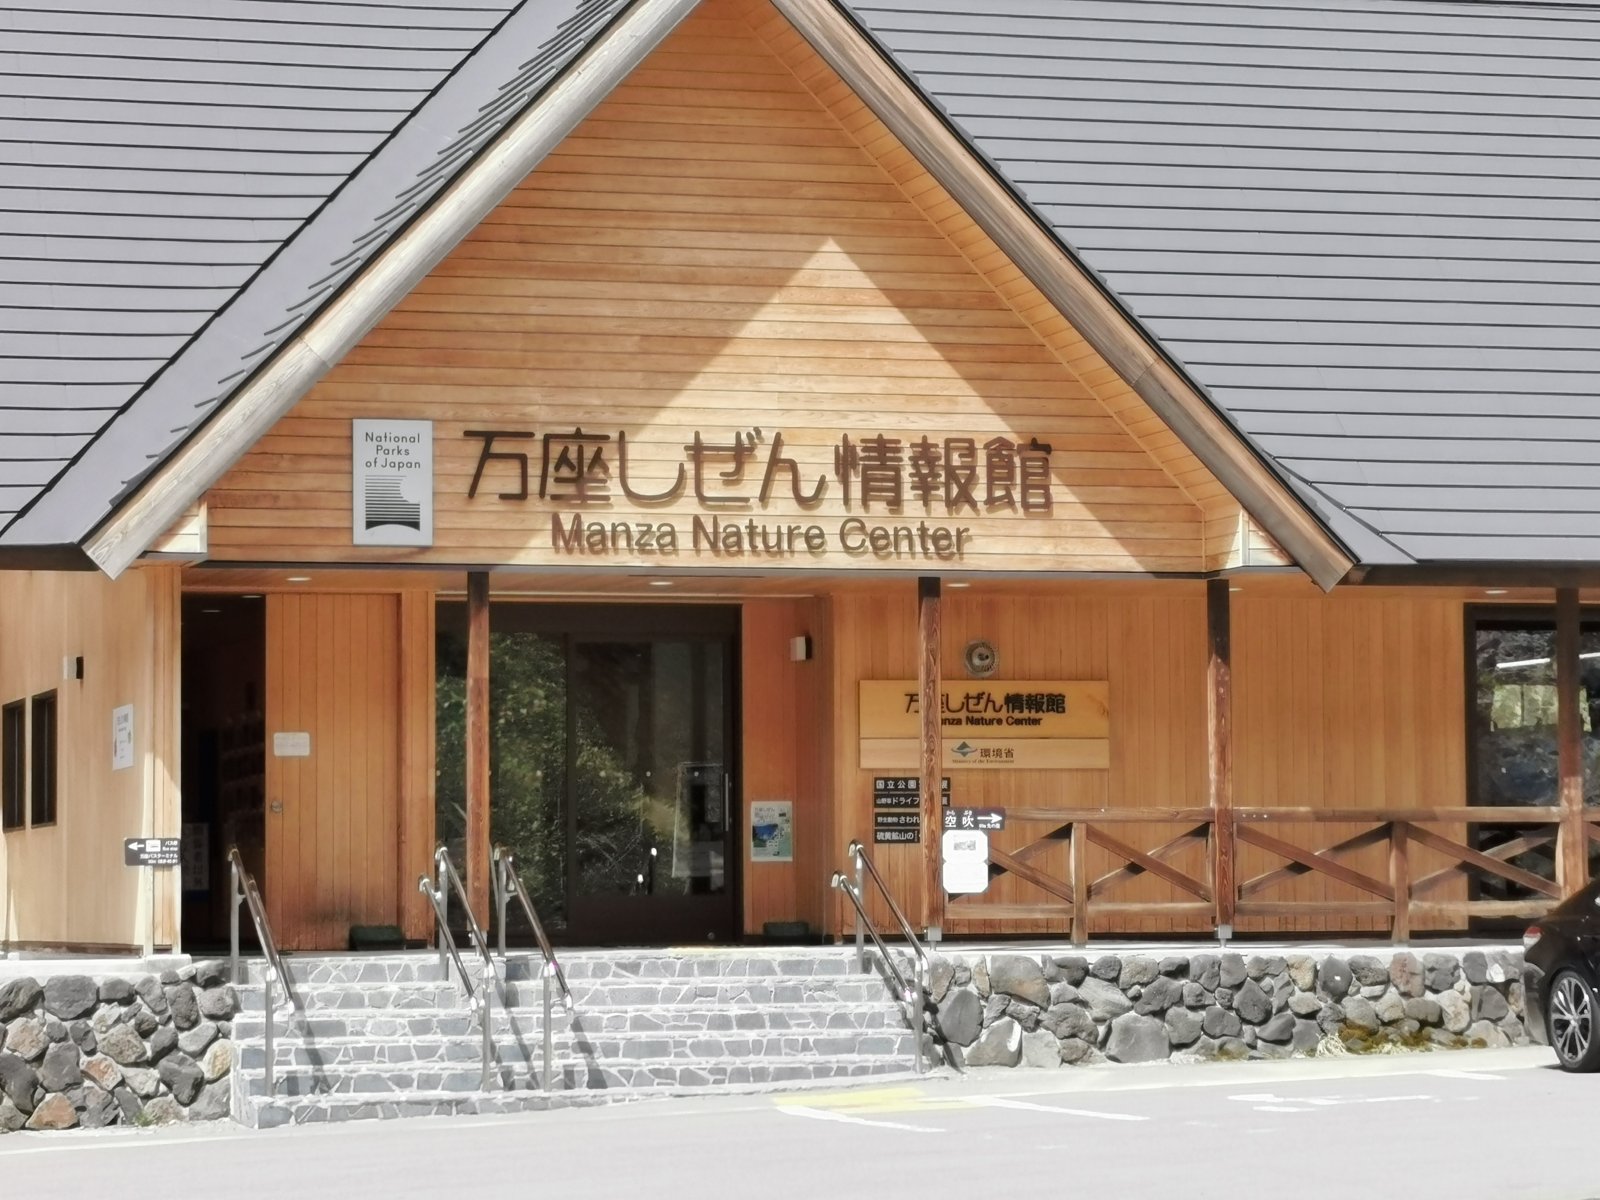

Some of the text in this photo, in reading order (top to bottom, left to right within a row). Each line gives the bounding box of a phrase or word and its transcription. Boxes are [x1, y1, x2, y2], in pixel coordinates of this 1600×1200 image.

[365, 432, 420, 443] National
[376, 445, 410, 456] Parks
[365, 457, 421, 471] of Japan
[463, 427, 1052, 512] 万座しぜん情報館
[551, 513, 970, 556] Manza Nature Center
[904, 692, 1066, 714] 万しぜん情報館
[966, 716, 1003, 726] Nature
[1006, 716, 1043, 726] Center
[980, 748, 1014, 758] 環境省
